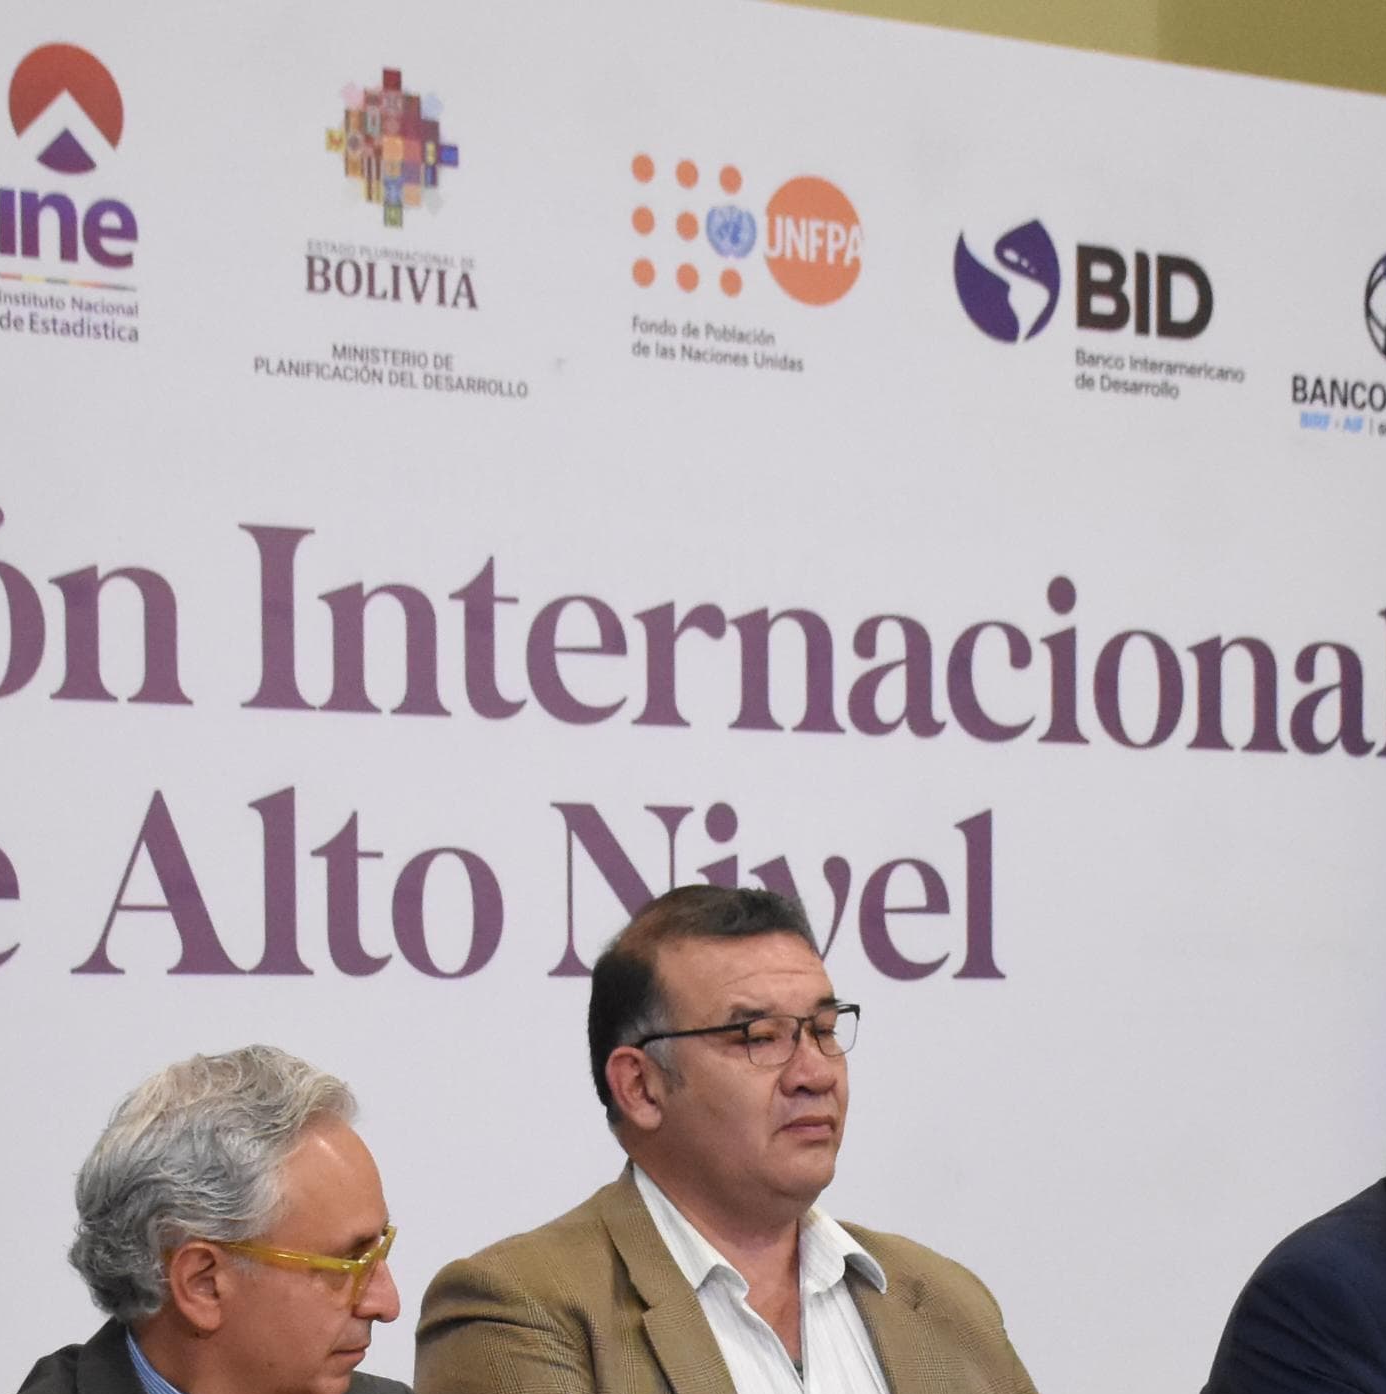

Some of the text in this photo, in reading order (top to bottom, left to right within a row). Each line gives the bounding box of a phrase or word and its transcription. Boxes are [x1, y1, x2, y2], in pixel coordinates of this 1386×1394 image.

[765, 214, 864, 267] UNFPA
[305, 255, 479, 310] BOLIVIA
[1076, 244, 1214, 340] BID
[0, 309, 24, 332] de
[71, 296, 139, 317] Nacional
[632, 315, 775, 346] Fondo de Población
[332, 344, 453, 371] MINISTERIO DE
[632, 341, 804, 373] de las Naciones Unidas
[1075, 348, 1245, 384] Banco Interamericano
[388, 369, 417, 389] DEL
[423, 374, 528, 398] DESARROLLO
[1075, 372, 1179, 399] de Desarrollo
[70, 785, 504, 980] Alto
